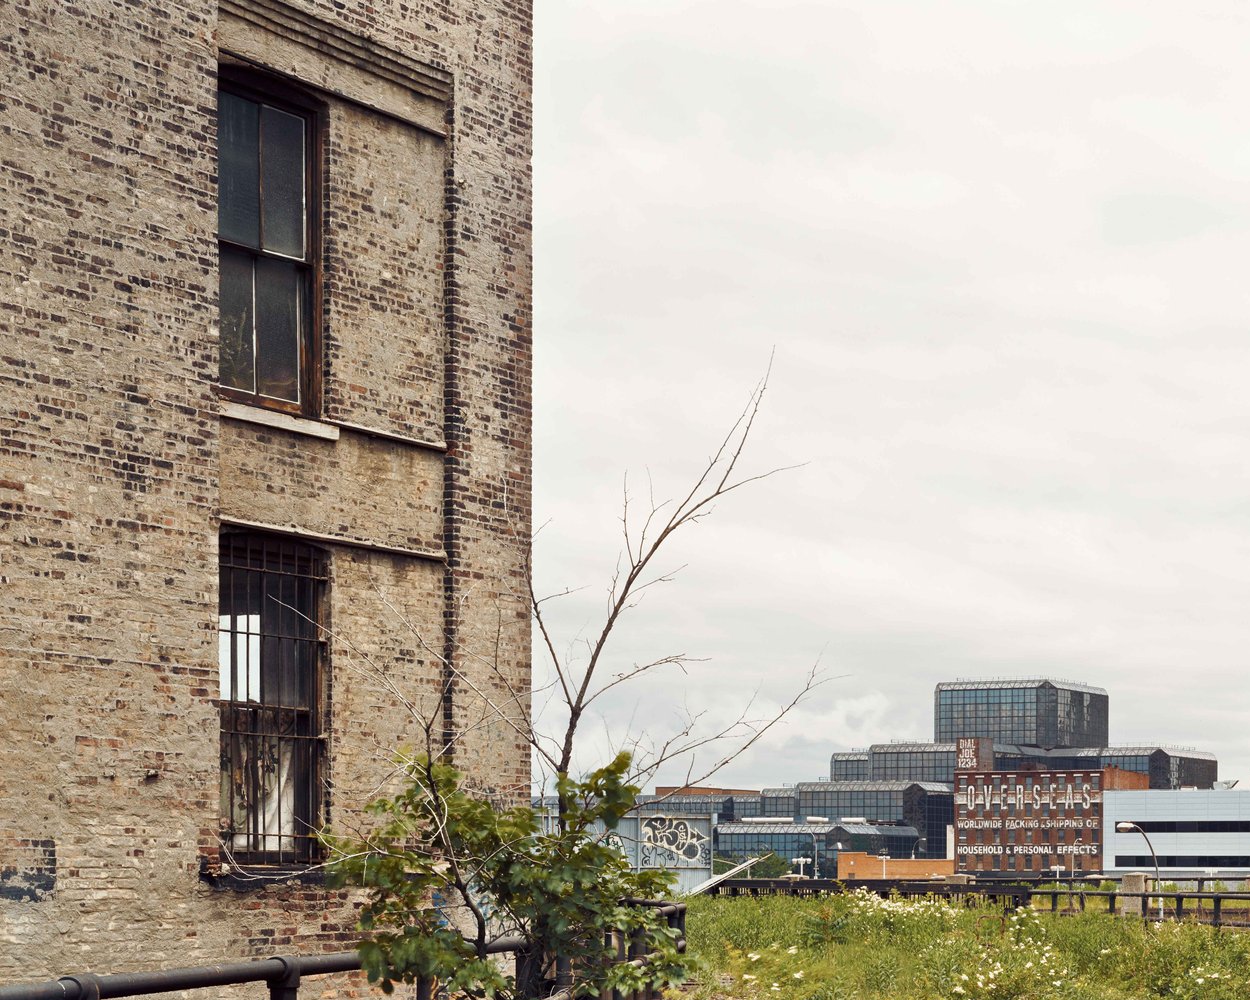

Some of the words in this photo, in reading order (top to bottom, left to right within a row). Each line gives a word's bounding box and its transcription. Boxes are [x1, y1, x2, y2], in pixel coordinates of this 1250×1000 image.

[959, 739, 976, 749] DIAL
[959, 749, 975, 758] JOE
[958, 758, 977, 768] 1234
[967, 784, 1091, 811] OVERSEAS
[957, 819, 1003, 829] WORLDWIDE
[1005, 819, 1039, 829] PACKING
[1086, 819, 1099, 828] OF
[957, 845, 1003, 855] HOUSEHOLD
[1005, 846, 1011, 854] &
[1013, 845, 1053, 855] PERSONAL
[1056, 845, 1098, 855] EFFECTS
